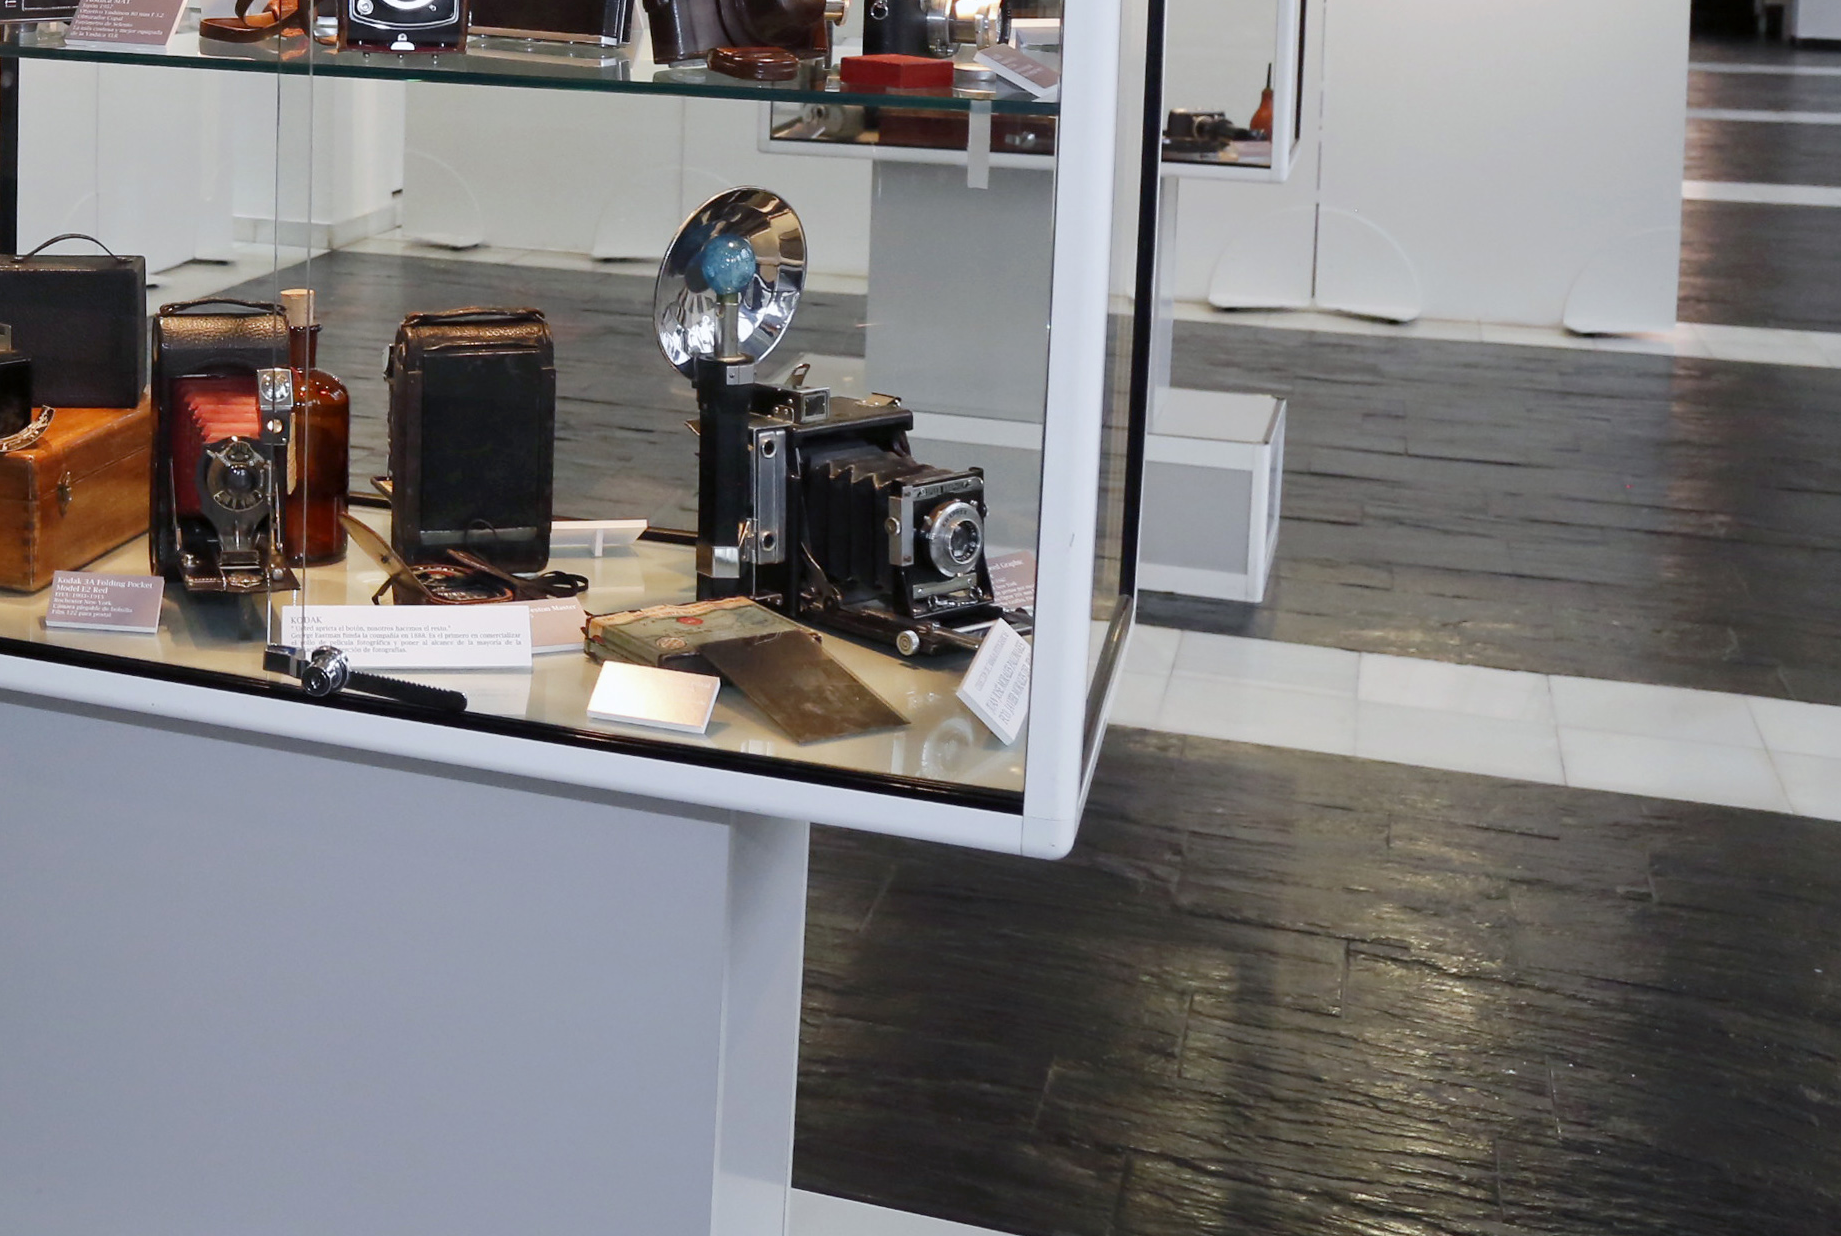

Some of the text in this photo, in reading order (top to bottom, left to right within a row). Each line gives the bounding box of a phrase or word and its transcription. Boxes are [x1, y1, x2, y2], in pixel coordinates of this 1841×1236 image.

[57, 576, 81, 585] Kodak
[96, 578, 126, 588] Folding
[127, 580, 154, 589] Pocket
[56, 584, 80, 592] Model
[93, 586, 108, 594] Red
[290, 616, 323, 624] KODAK
[444, 632, 469, 640] primero
